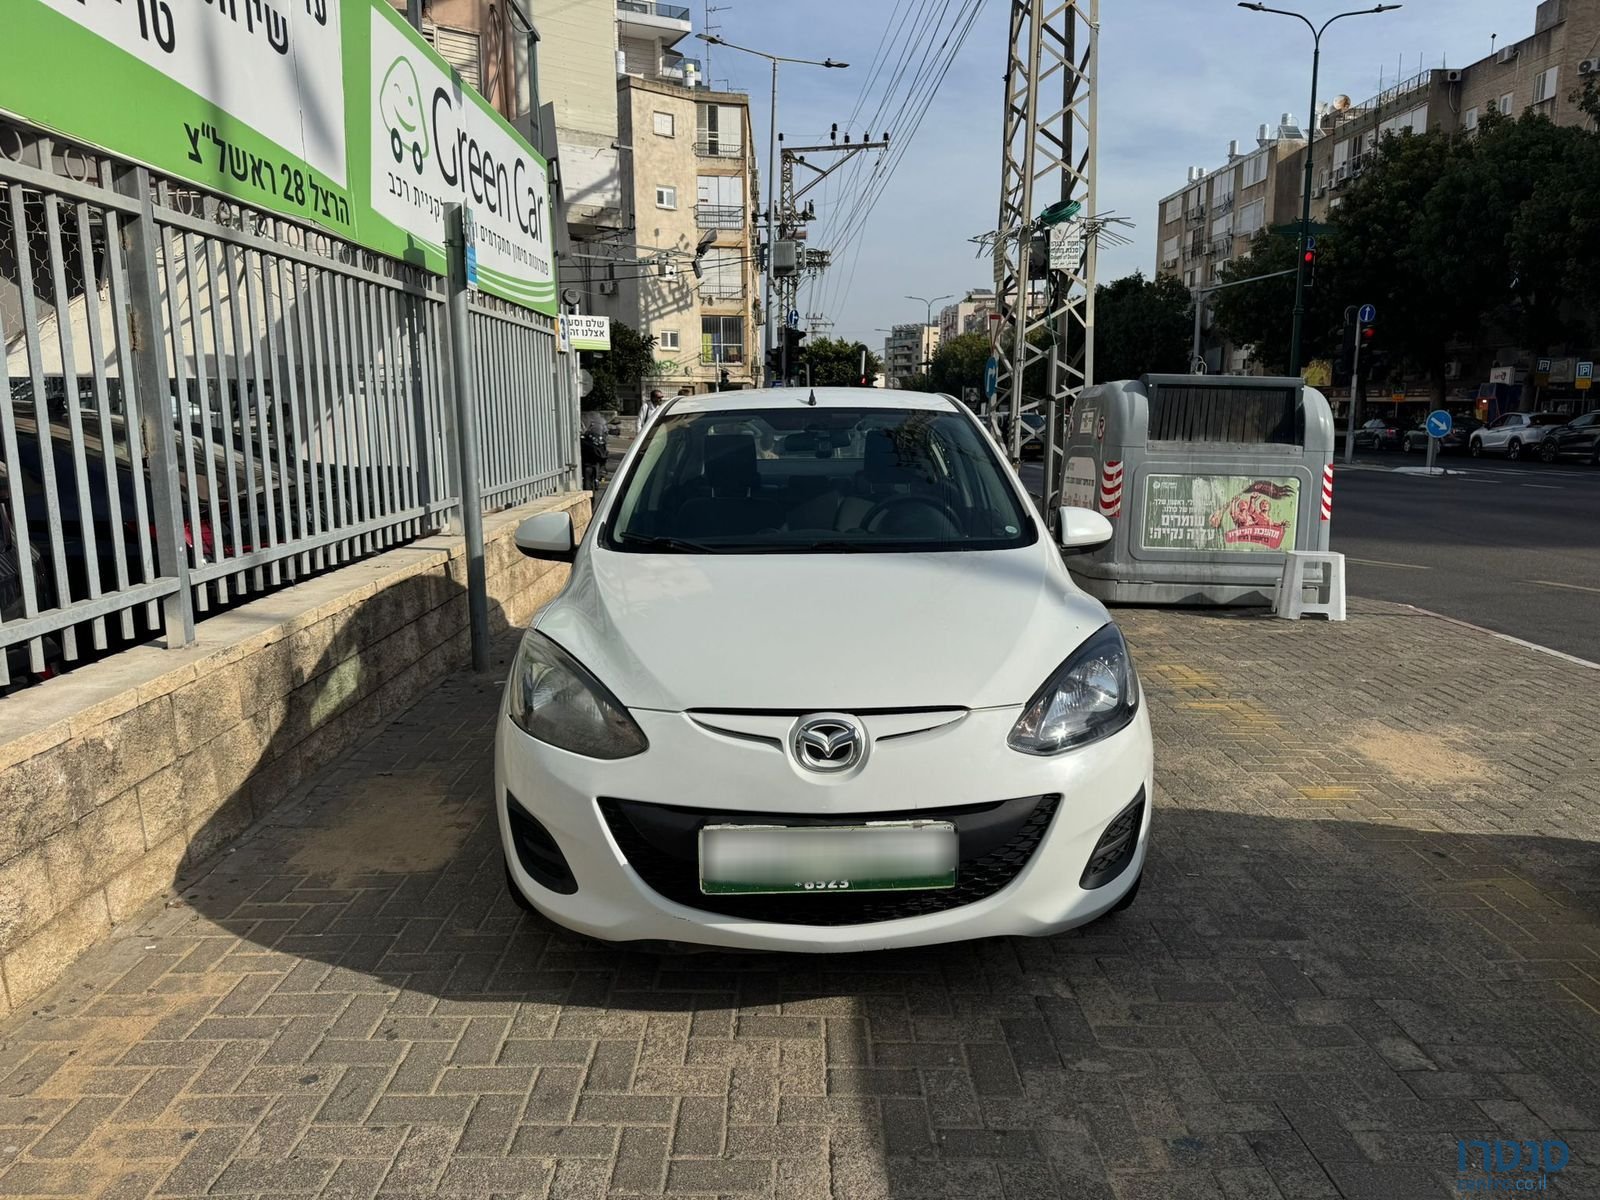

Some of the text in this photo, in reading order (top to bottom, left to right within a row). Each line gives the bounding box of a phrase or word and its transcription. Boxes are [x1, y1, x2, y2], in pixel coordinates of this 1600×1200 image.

[432, 86, 543, 243] Green Car
[280, 163, 306, 207] 28
[388, 172, 410, 202] רכב
[308, 173, 350, 226] הרצל
[581, 328, 605, 337] אצלנו
[585, 318, 605, 328] שלם
[1161, 514, 1206, 526] שומרים
[1149, 527, 1184, 541] נקייה!
